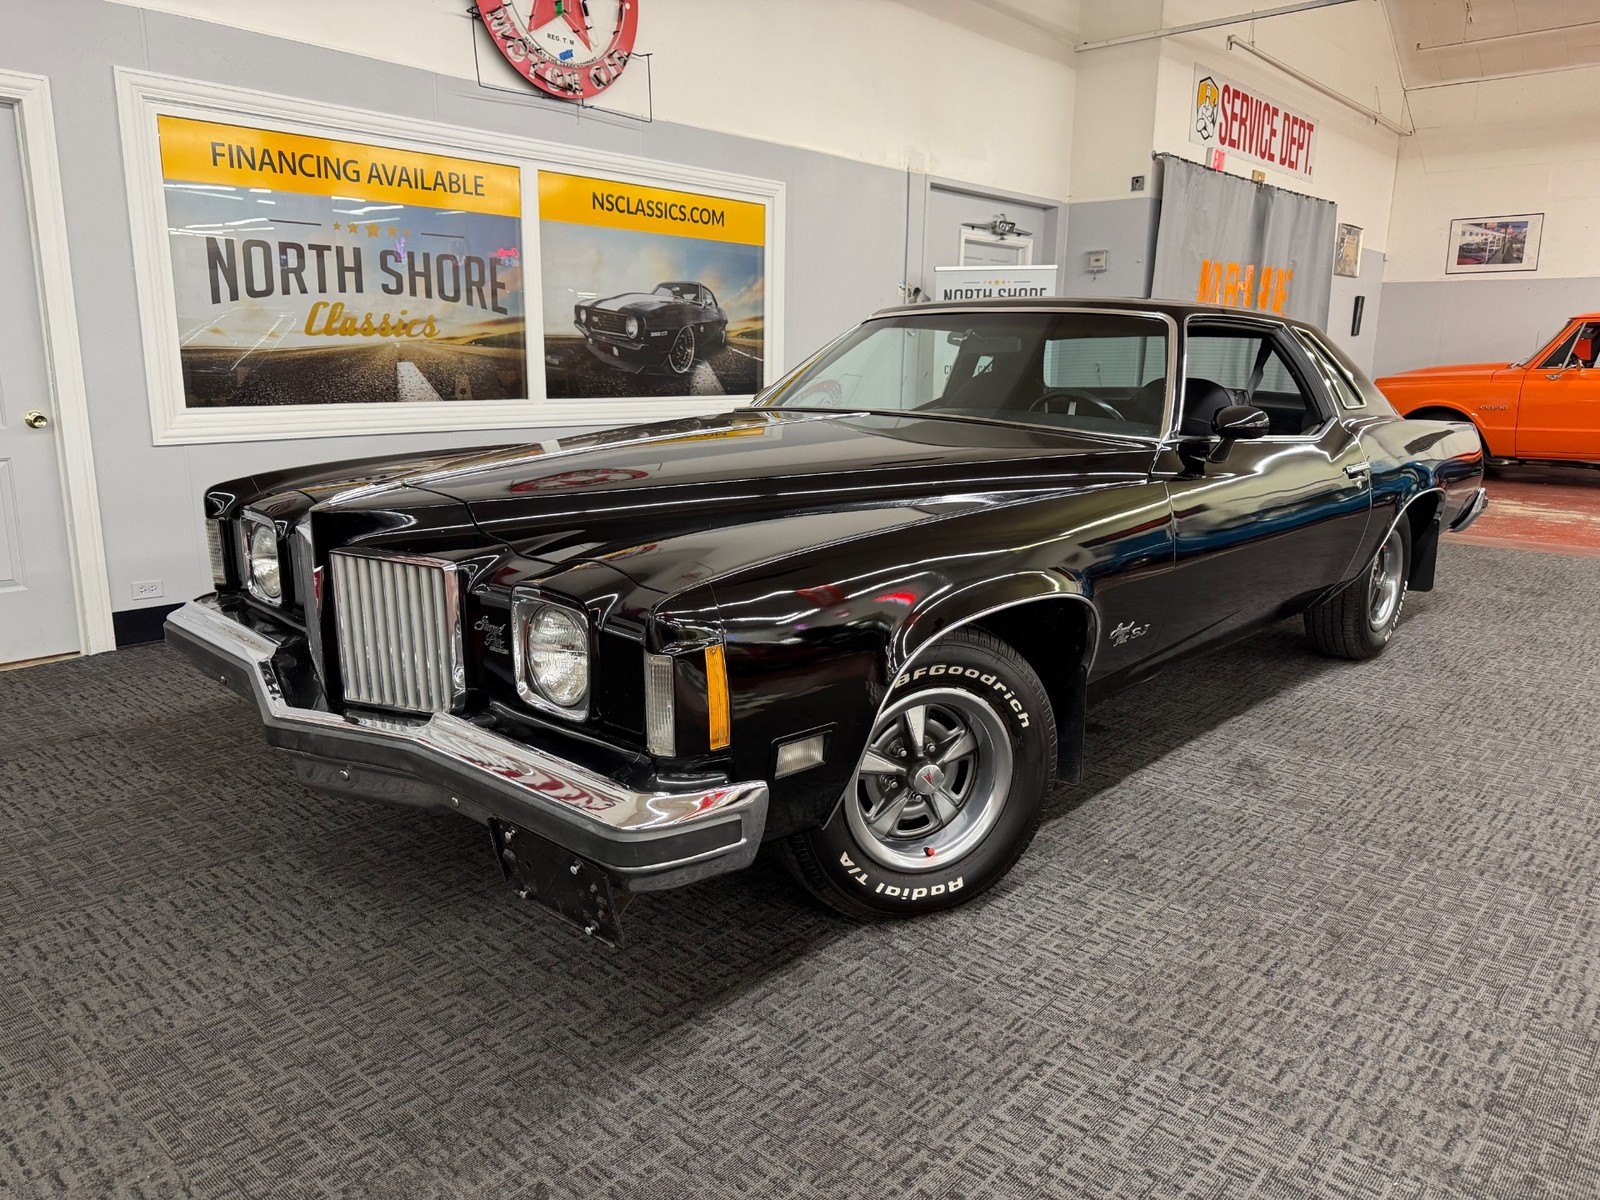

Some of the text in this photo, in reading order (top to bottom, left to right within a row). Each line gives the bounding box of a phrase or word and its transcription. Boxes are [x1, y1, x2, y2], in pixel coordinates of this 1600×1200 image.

[1218, 84, 1314, 176] SERVICE DEPT.
[210, 141, 485, 197] FINANCING AVAILABLE
[592, 191, 725, 227] NSCLASSICS.COM
[205, 236, 508, 315] NORTH SHORE
[304, 301, 441, 338] Classics
[894, 664, 1030, 728] BFGoodrich
[839, 851, 964, 901] Radial T/A
